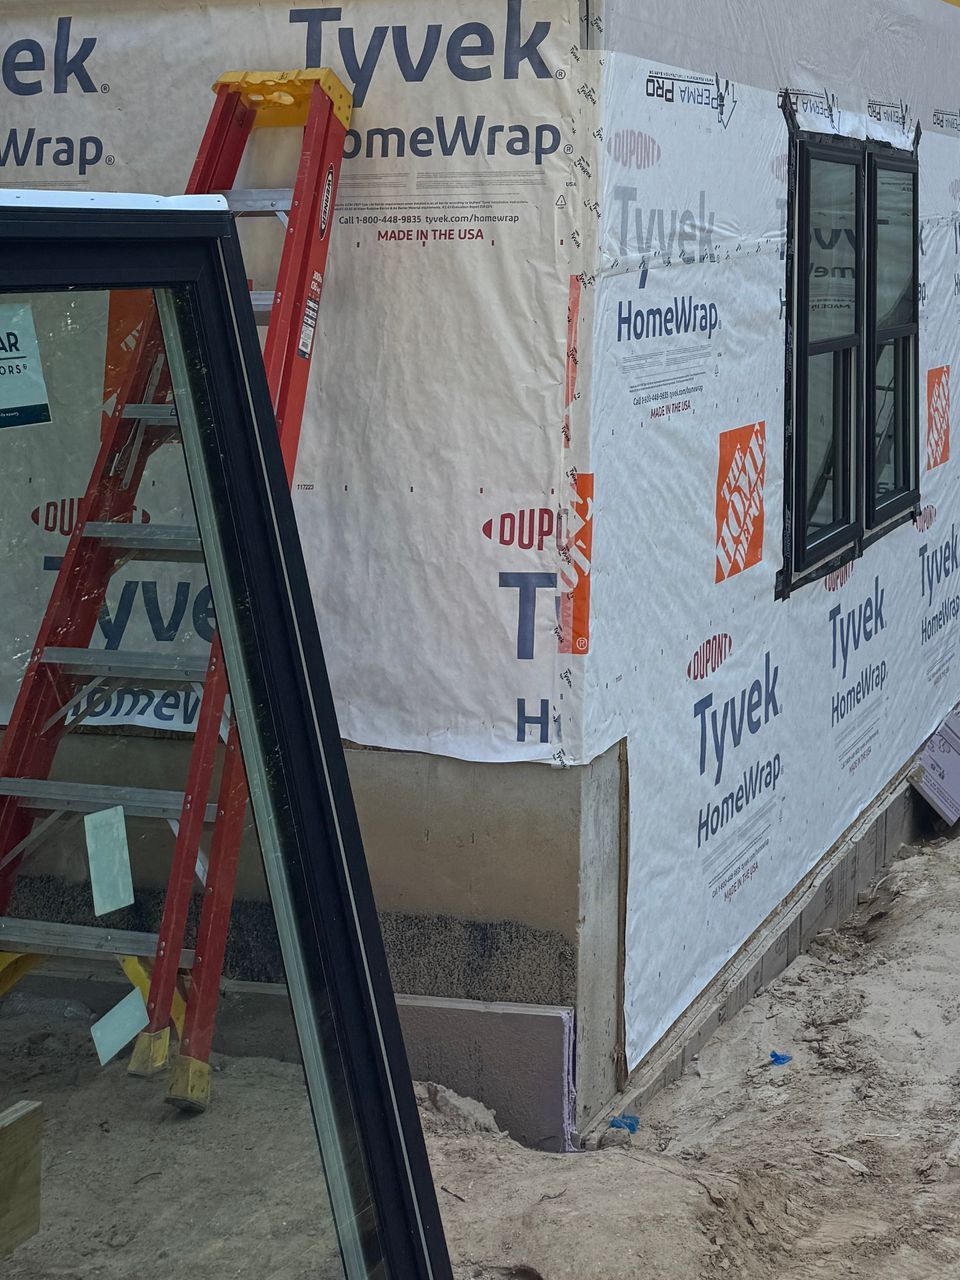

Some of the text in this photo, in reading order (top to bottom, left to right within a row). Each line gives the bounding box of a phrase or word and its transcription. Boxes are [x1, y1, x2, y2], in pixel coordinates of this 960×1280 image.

[645, 78, 720, 111] PERMA PRO
[867, 104, 882, 121] PRO
[340, 115, 563, 165] omeWrap
[613, 128, 657, 170] DUPONT
[321, 176, 333, 225] WERNER
[339, 214, 520, 225] Call 1-800-448-9835 tyvek.com/homewrap
[377, 228, 484, 241] MADE IN THE USA
[613, 185, 716, 289] Tyvek
[617, 295, 719, 343] HomeWrap
[650, 399, 691, 420] MADE IN THE USA
[918, 523, 960, 607] Tyvek
[828, 575, 886, 680] Tyvek
[921, 594, 960, 646] HomeWrap
[693, 632, 728, 681] DUPONT
[831, 659, 887, 728] HomeWrap
[693, 650, 780, 787] Tyvek
[697, 752, 781, 849] HomeWrap
[723, 882, 737, 903] MADE
[742, 870, 751, 884] THE
[750, 860, 759, 878] USA
